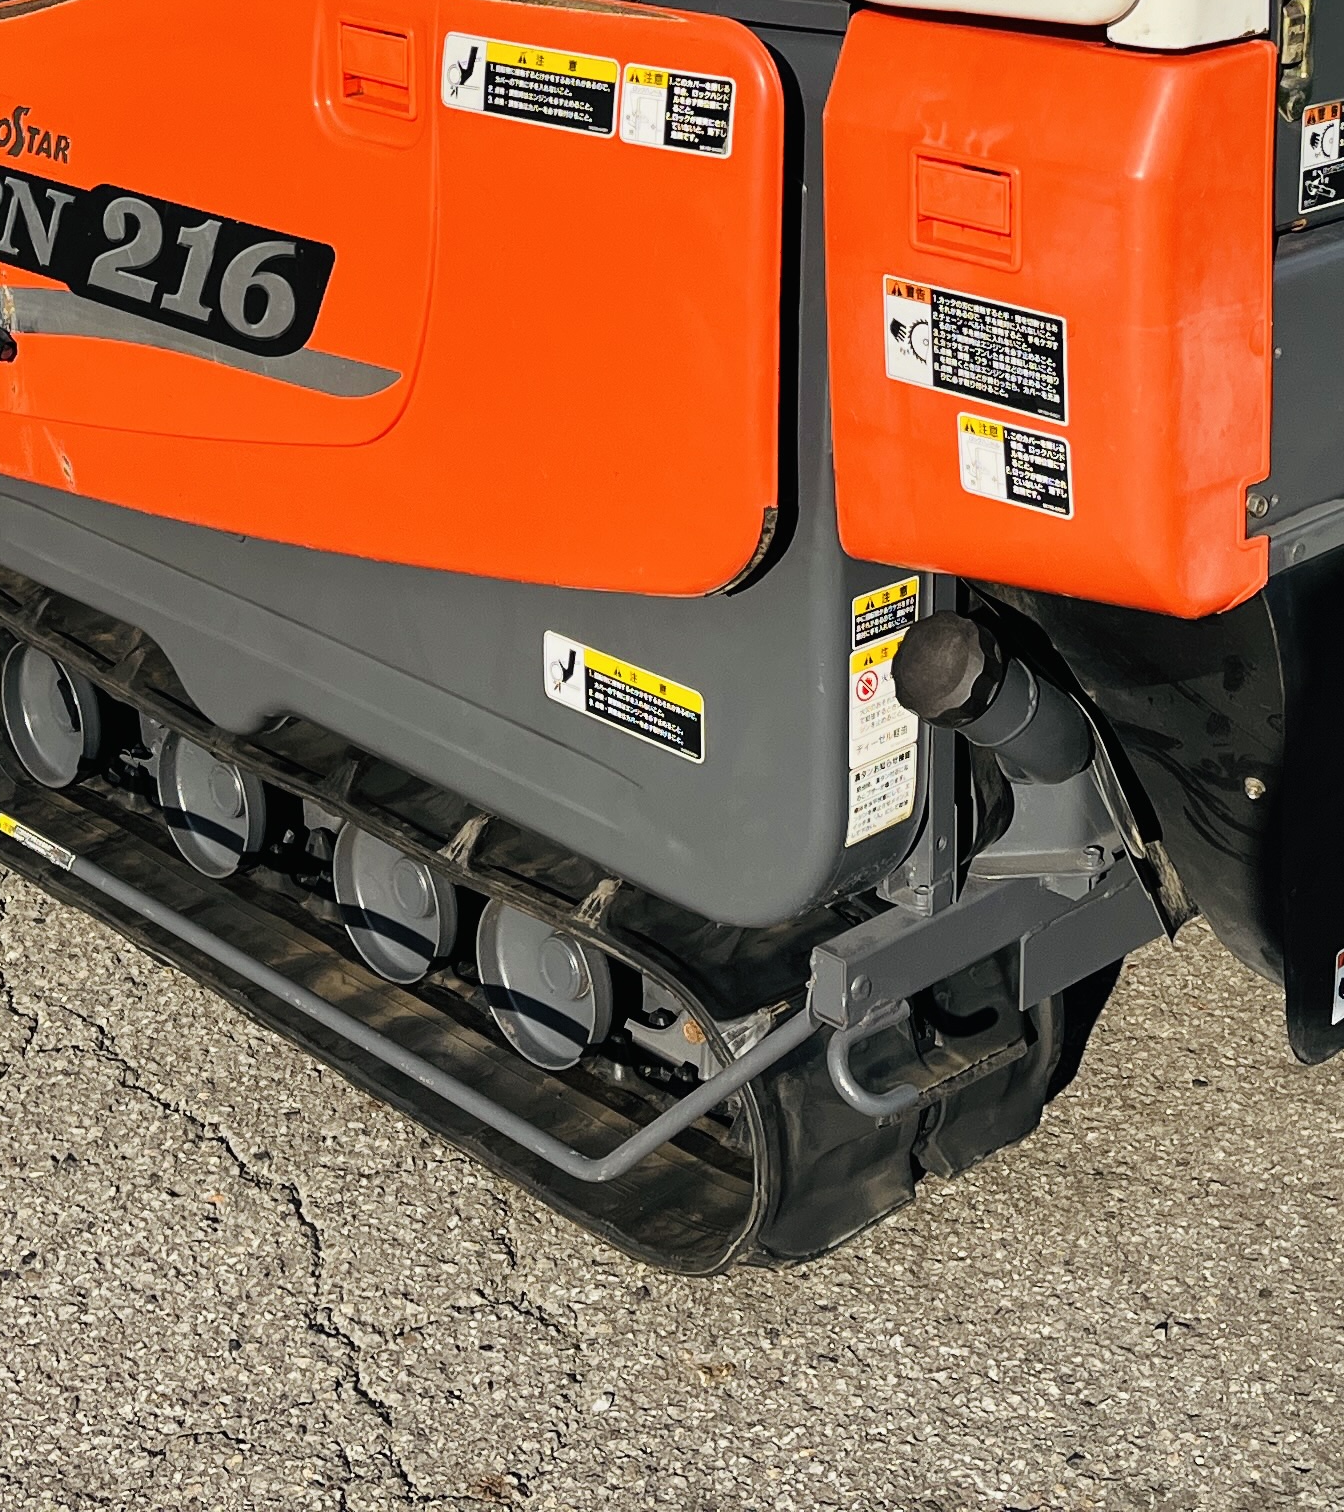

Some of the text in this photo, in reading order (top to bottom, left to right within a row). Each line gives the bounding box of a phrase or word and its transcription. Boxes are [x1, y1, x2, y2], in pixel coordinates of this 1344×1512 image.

[535, 53, 577, 72] 注意
[644, 72, 663, 86] 注意
[88, 195, 298, 341] 216
[906, 284, 926, 300] 警告
[979, 421, 998, 437] 注意
[882, 584, 907, 604] 注意
[857, 725, 908, 752] ディーゼル軽油
